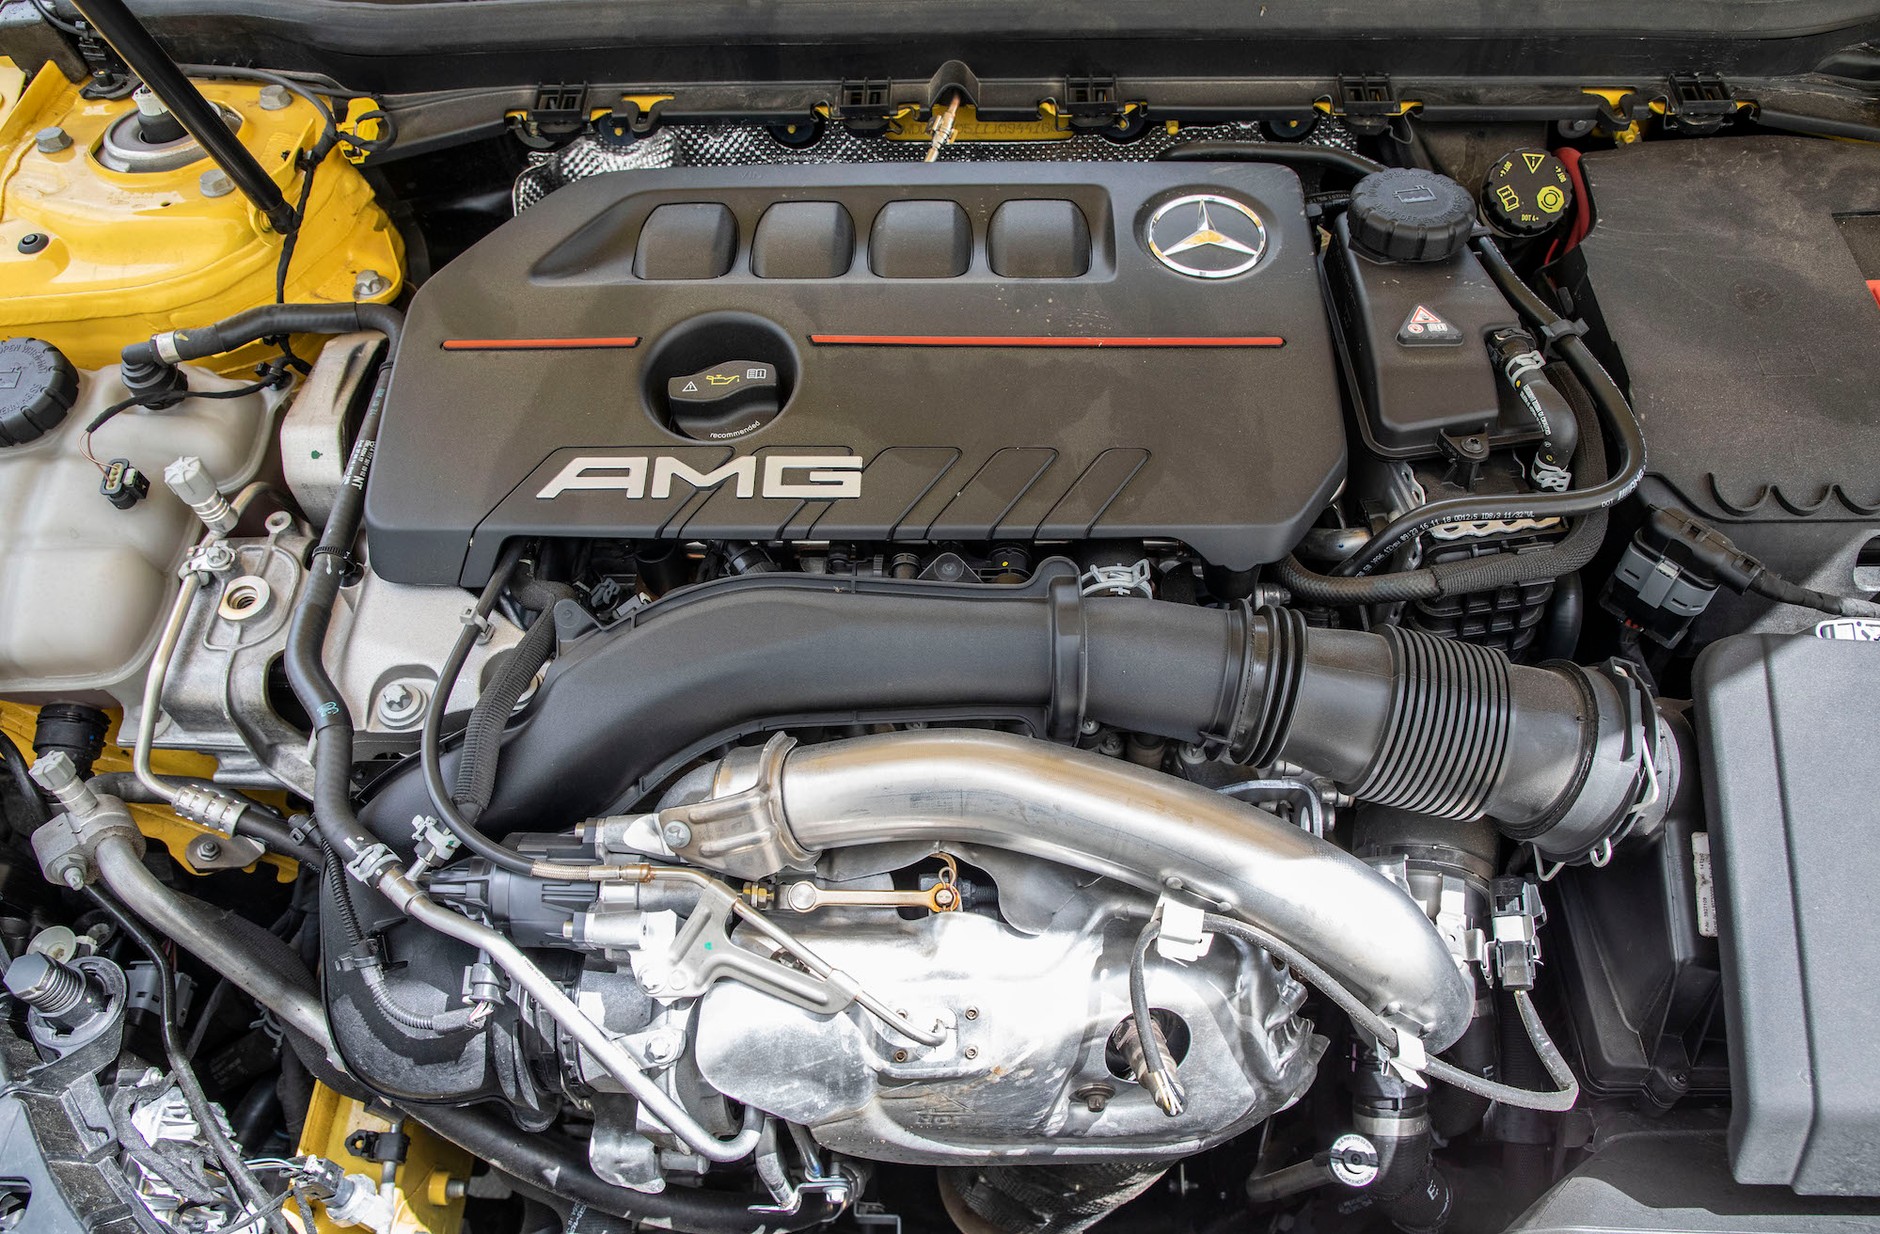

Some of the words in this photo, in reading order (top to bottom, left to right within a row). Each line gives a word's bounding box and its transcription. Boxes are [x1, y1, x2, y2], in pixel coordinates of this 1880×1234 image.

[1521, 214, 1532, 222] DOT
[709, 420, 761, 438] recommended
[536, 455, 863, 499] AMG
